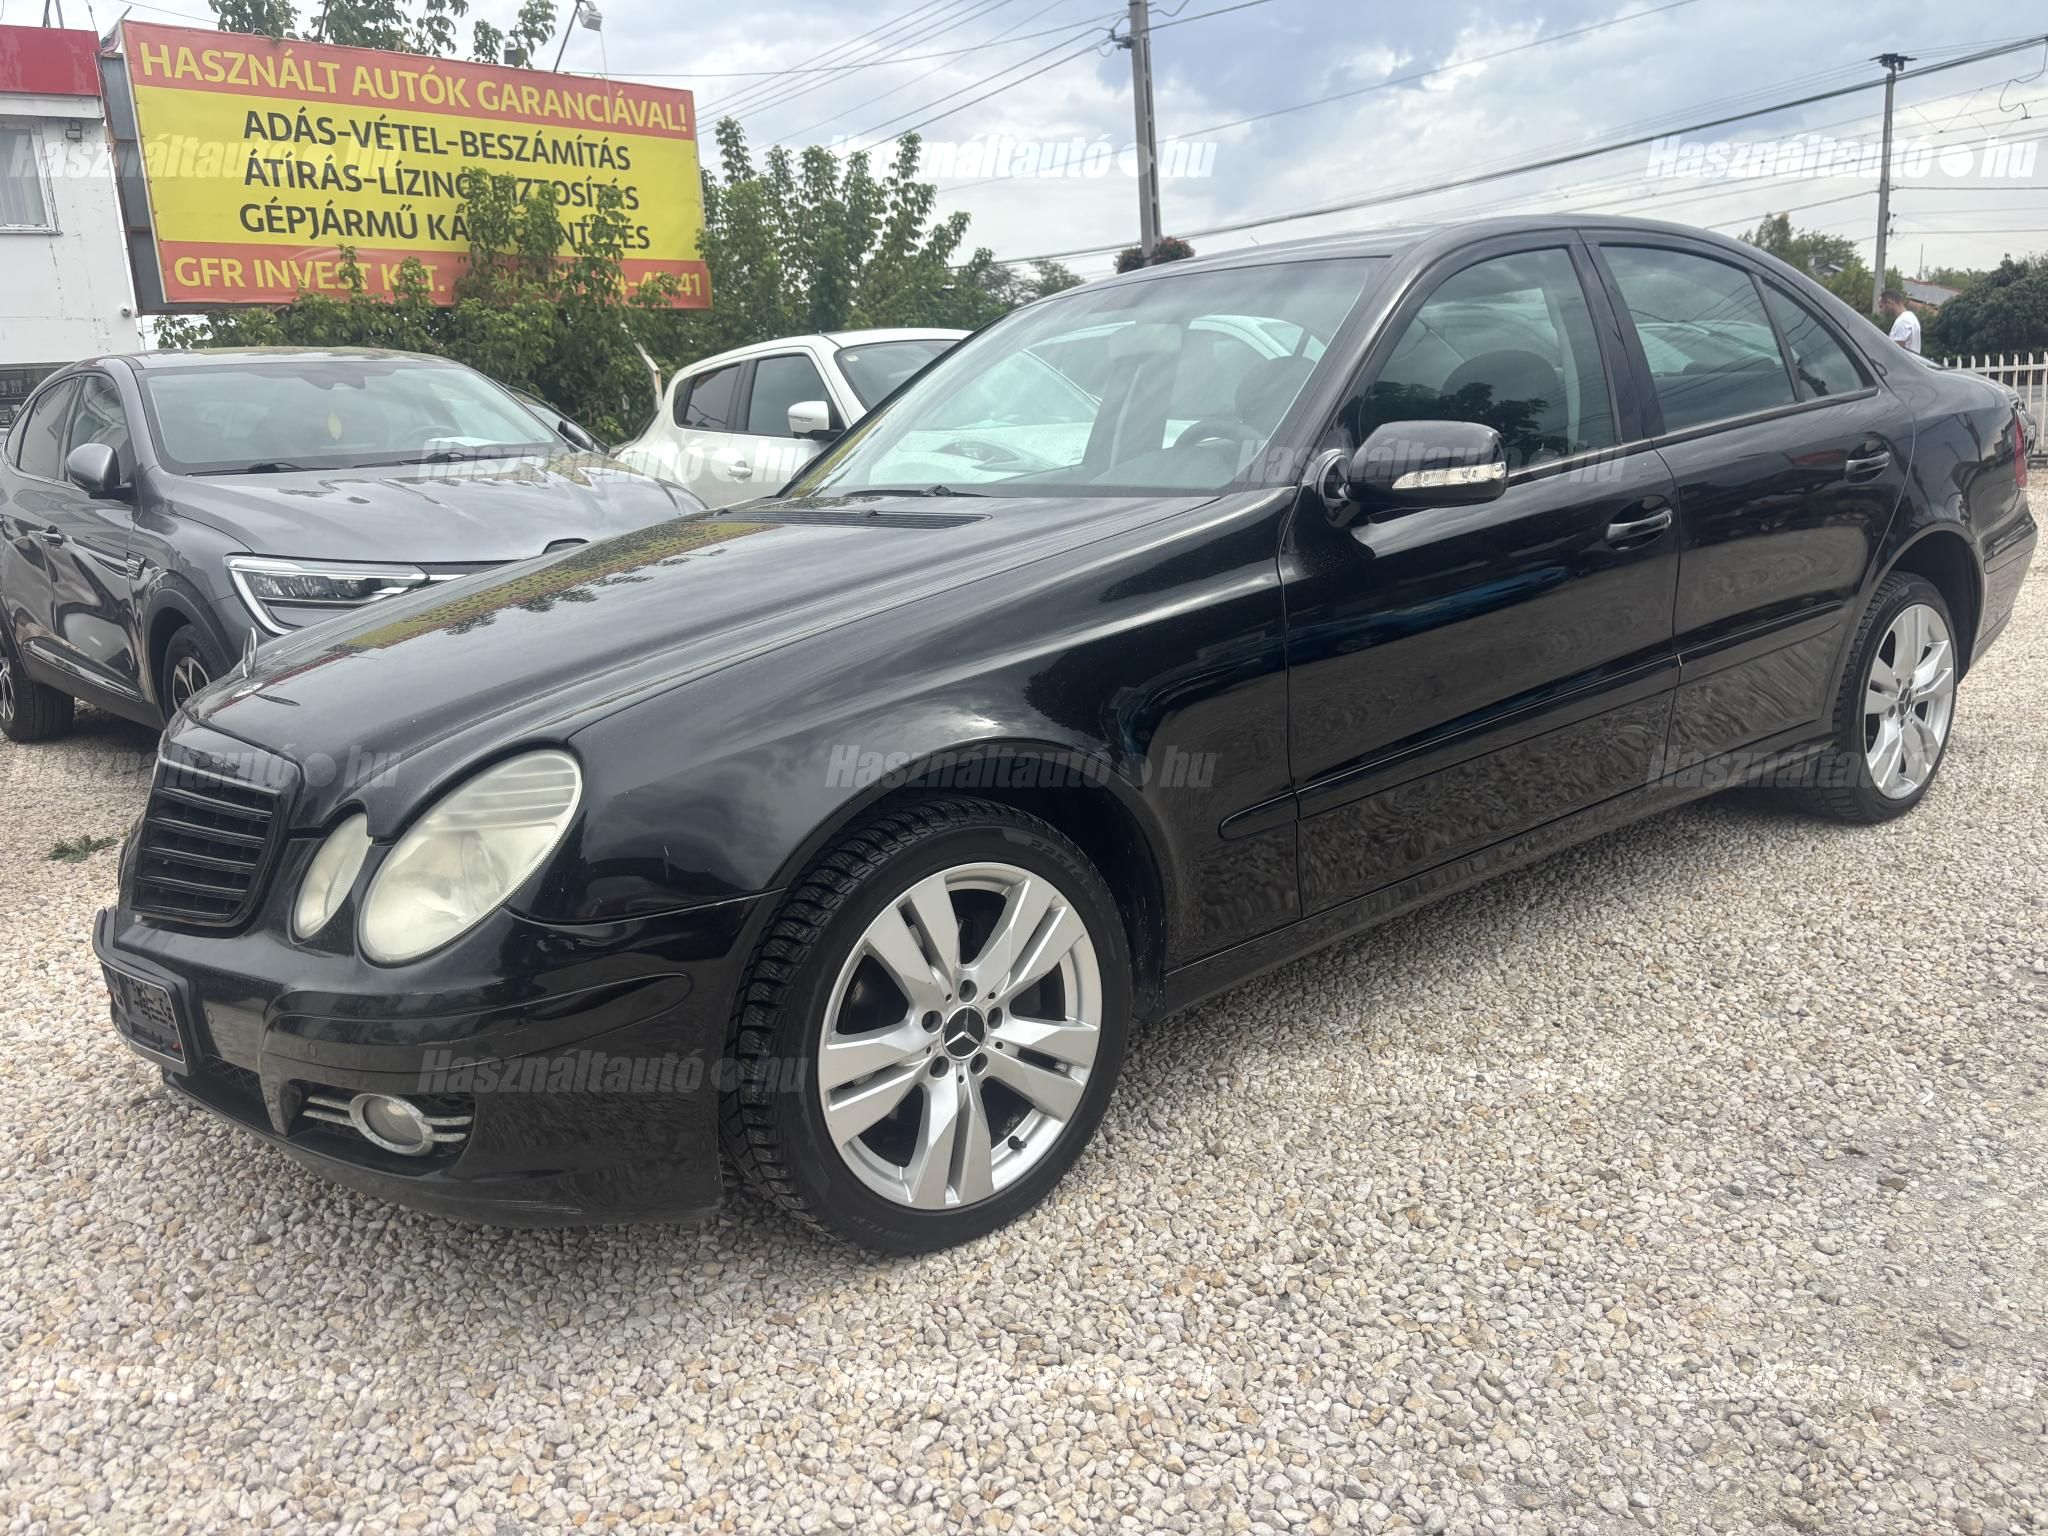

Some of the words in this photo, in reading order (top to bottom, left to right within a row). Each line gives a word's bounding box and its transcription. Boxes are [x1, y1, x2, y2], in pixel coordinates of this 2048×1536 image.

[139, 42, 340, 93] HASZNÁLT
[352, 65, 471, 108] AUTÓK
[477, 79, 687, 132] GARANCIÁVAL!
[243, 106, 631, 171] ADÁS-VÉTEL-BESZÁMÍTÁS
[243, 148, 639, 210] ÁTÍRÁS-LÍZINGIZTOSÍTS
[239, 196, 418, 240] GÉPJÁRMŰ
[174, 256, 246, 288] GFR
[253, 259, 372, 290] INVEST
[381, 262, 445, 292] KT.
